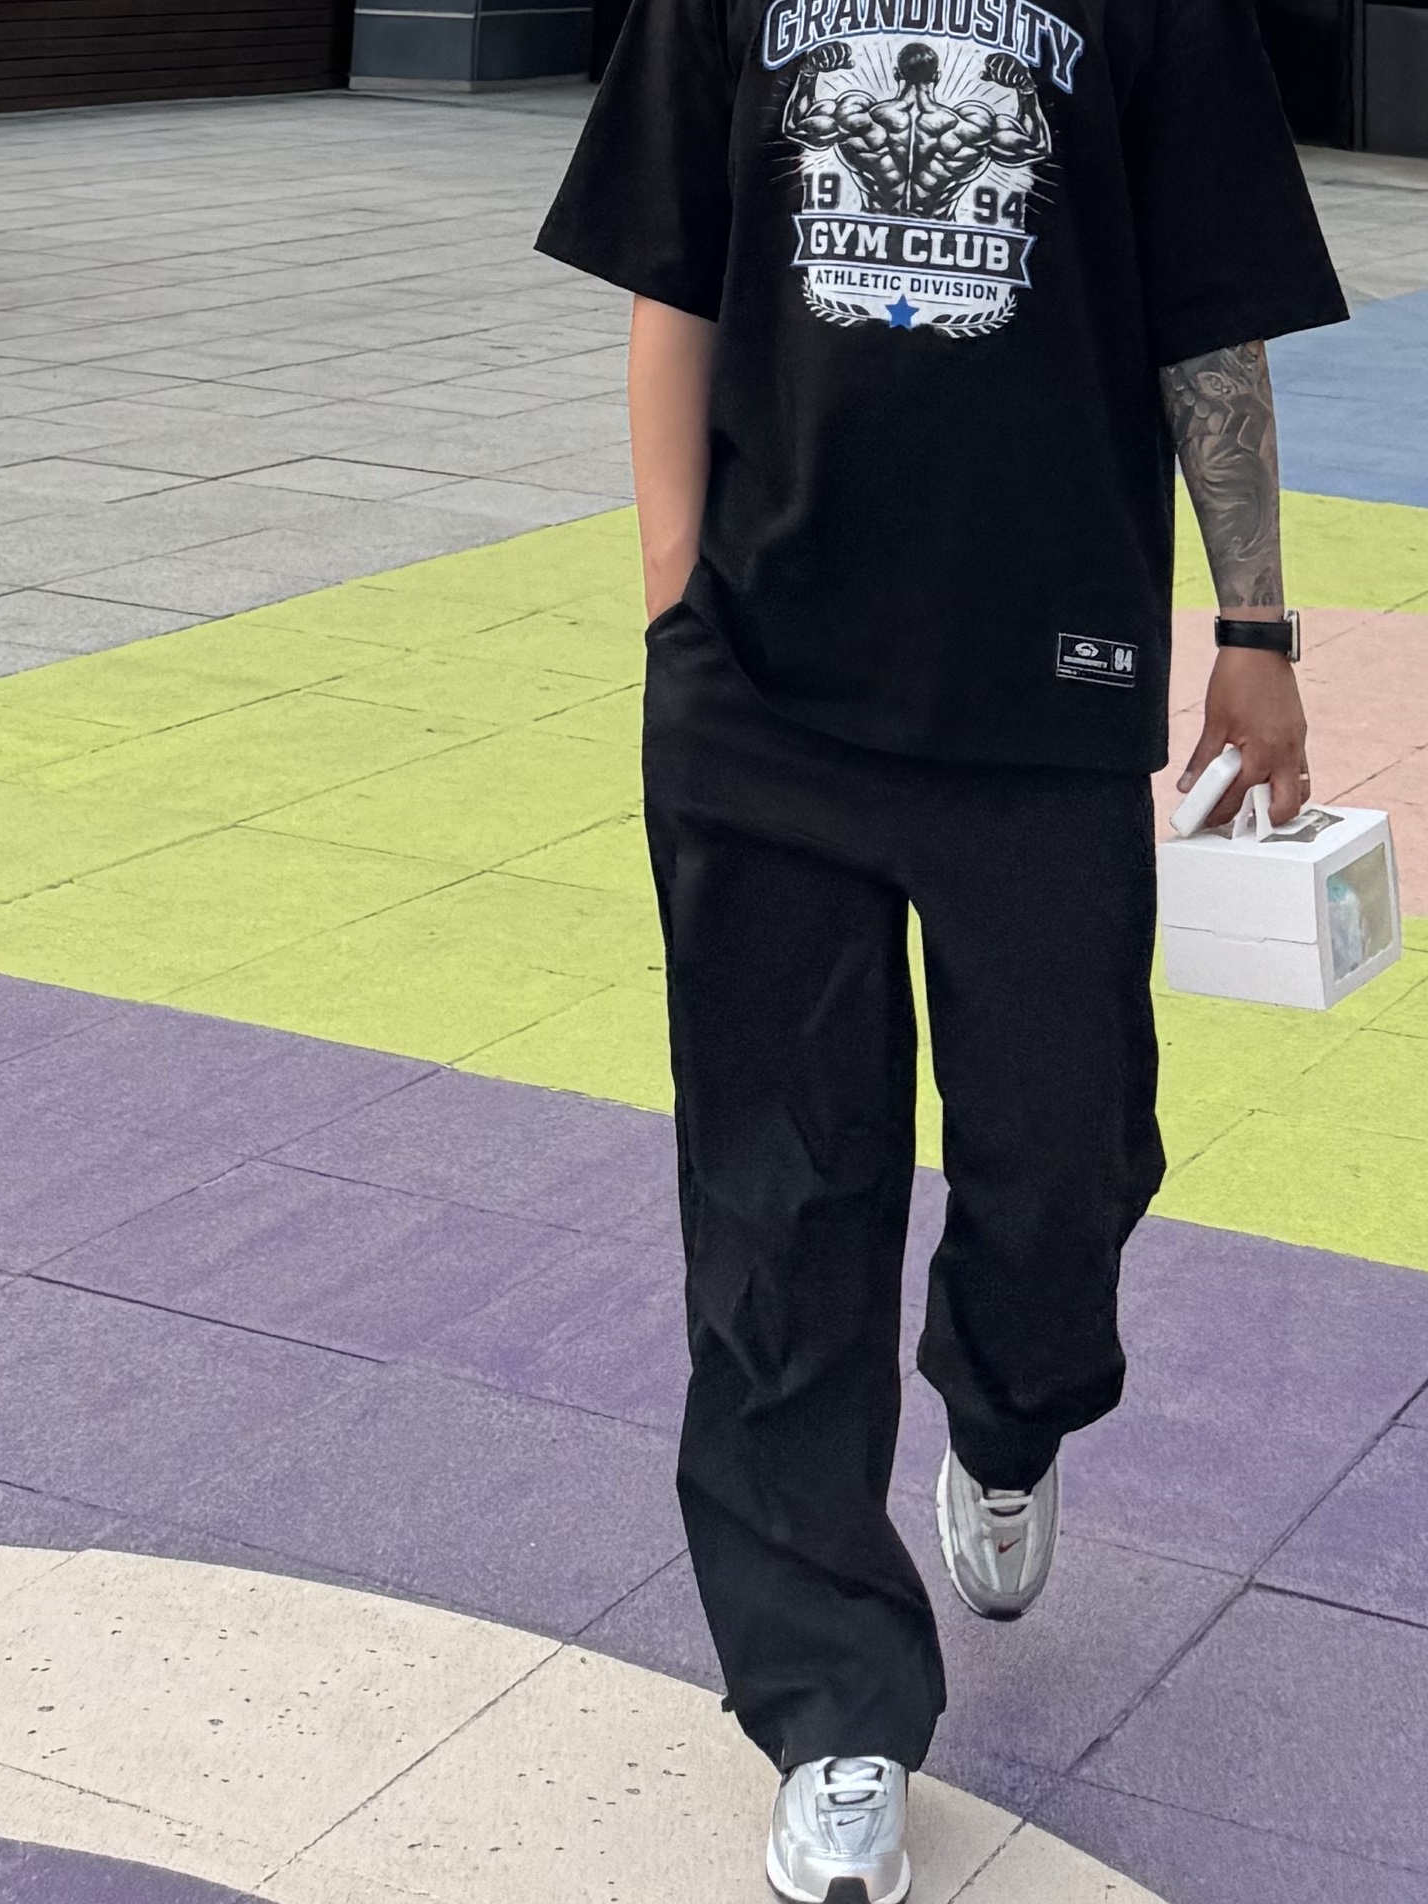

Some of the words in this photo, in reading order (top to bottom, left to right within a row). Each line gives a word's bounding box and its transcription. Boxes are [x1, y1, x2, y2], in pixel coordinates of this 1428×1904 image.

[802, 172, 842, 211] 19
[972, 186, 1026, 230] 94
[809, 220, 890, 260] GYM
[901, 227, 1011, 272] CLUB
[814, 268, 903, 292] ATHLETIC
[909, 277, 999, 302] DIVISION
